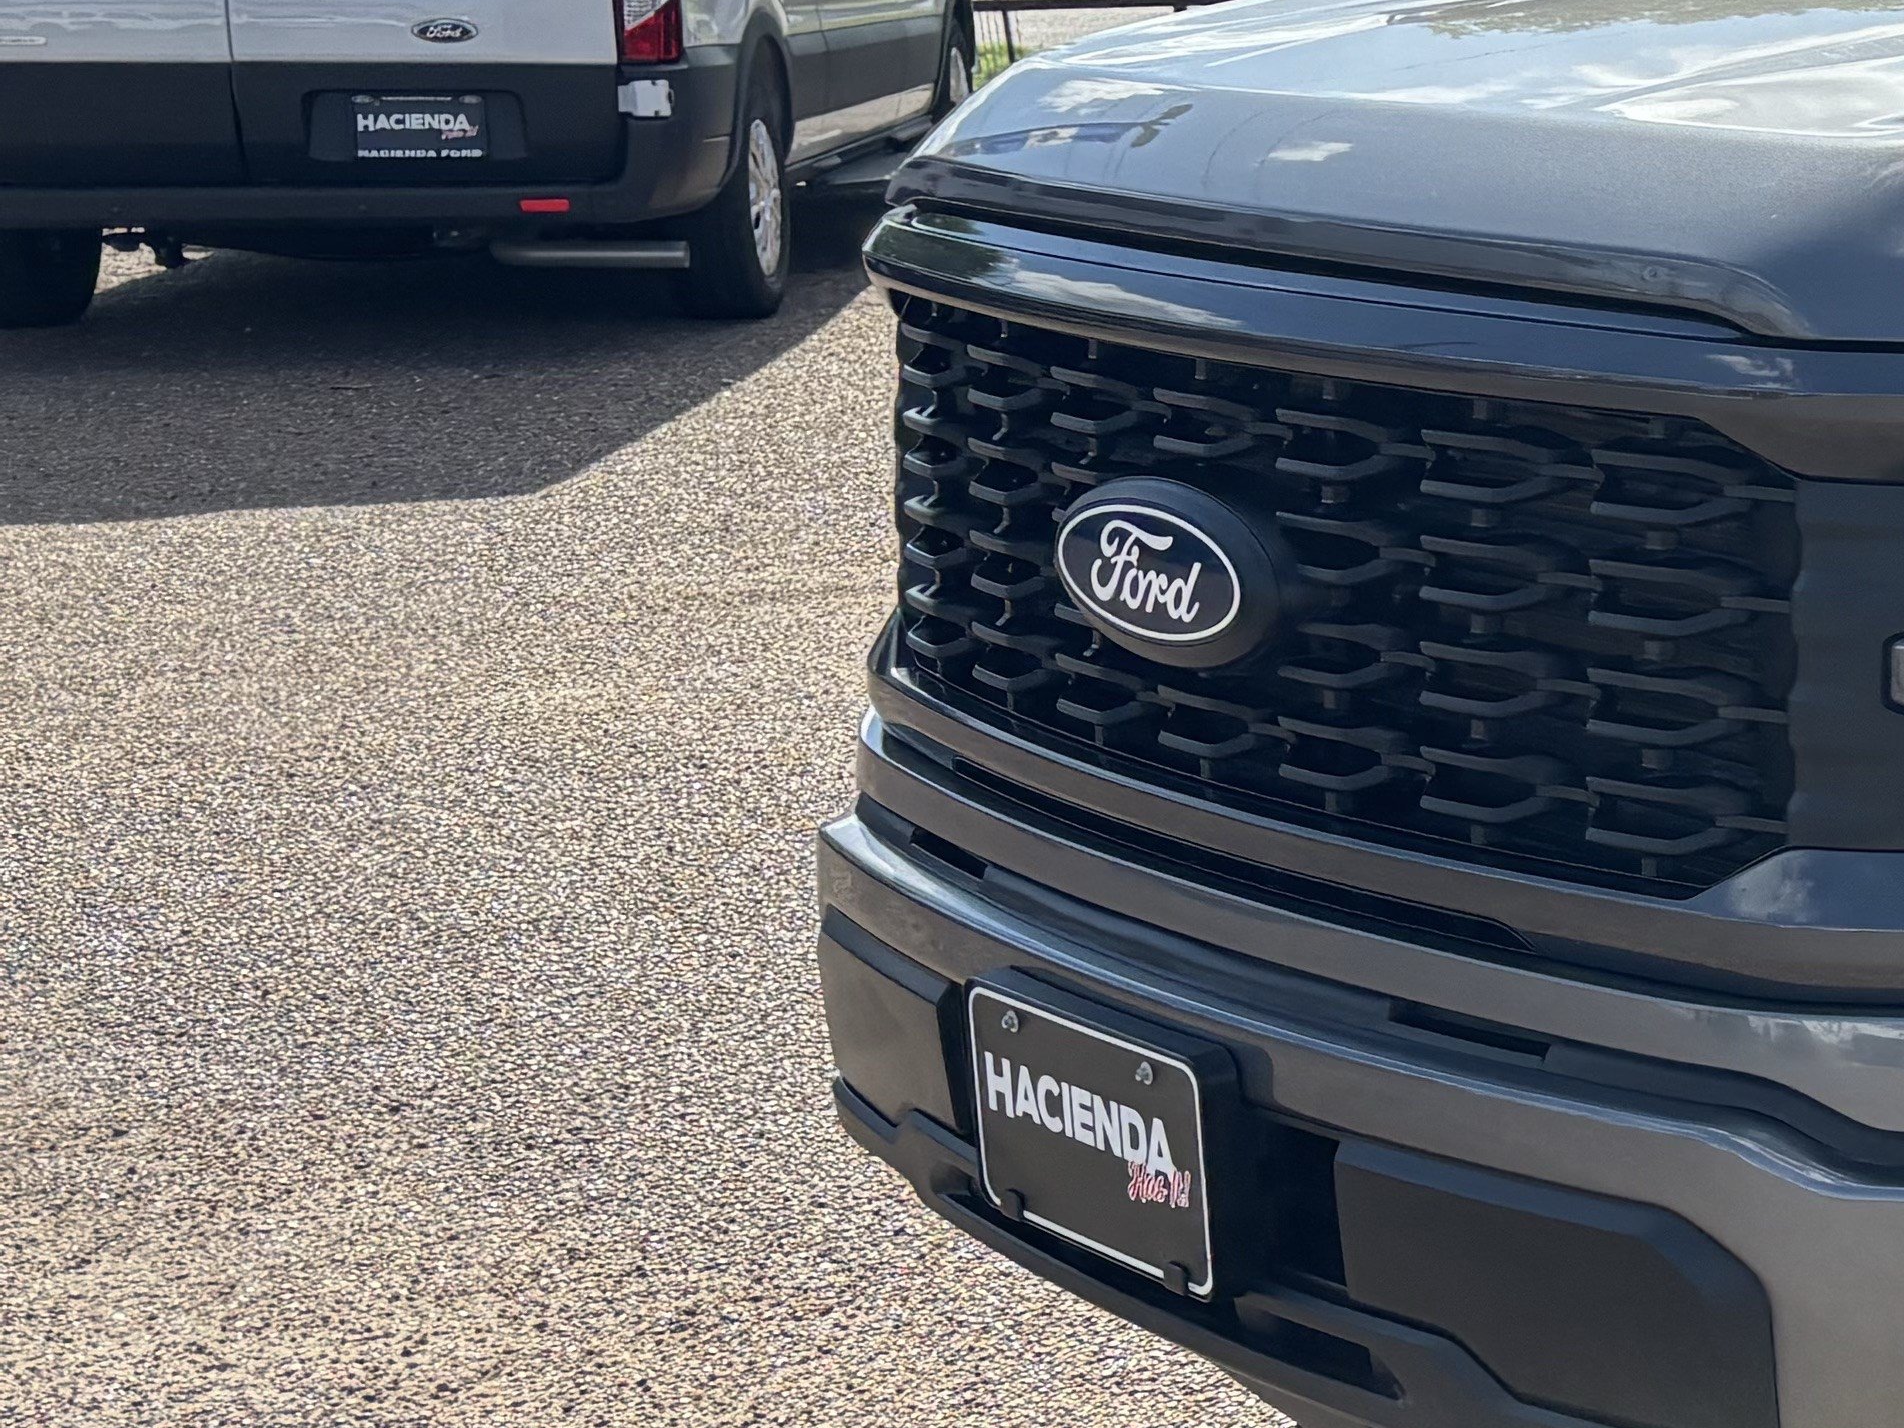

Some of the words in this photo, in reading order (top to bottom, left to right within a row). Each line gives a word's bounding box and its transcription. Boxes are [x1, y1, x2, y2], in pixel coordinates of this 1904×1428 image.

[356, 113, 470, 132] HACIENDA
[1090, 519, 1202, 623] Ford
[984, 1051, 1179, 1178] HACIENDA
